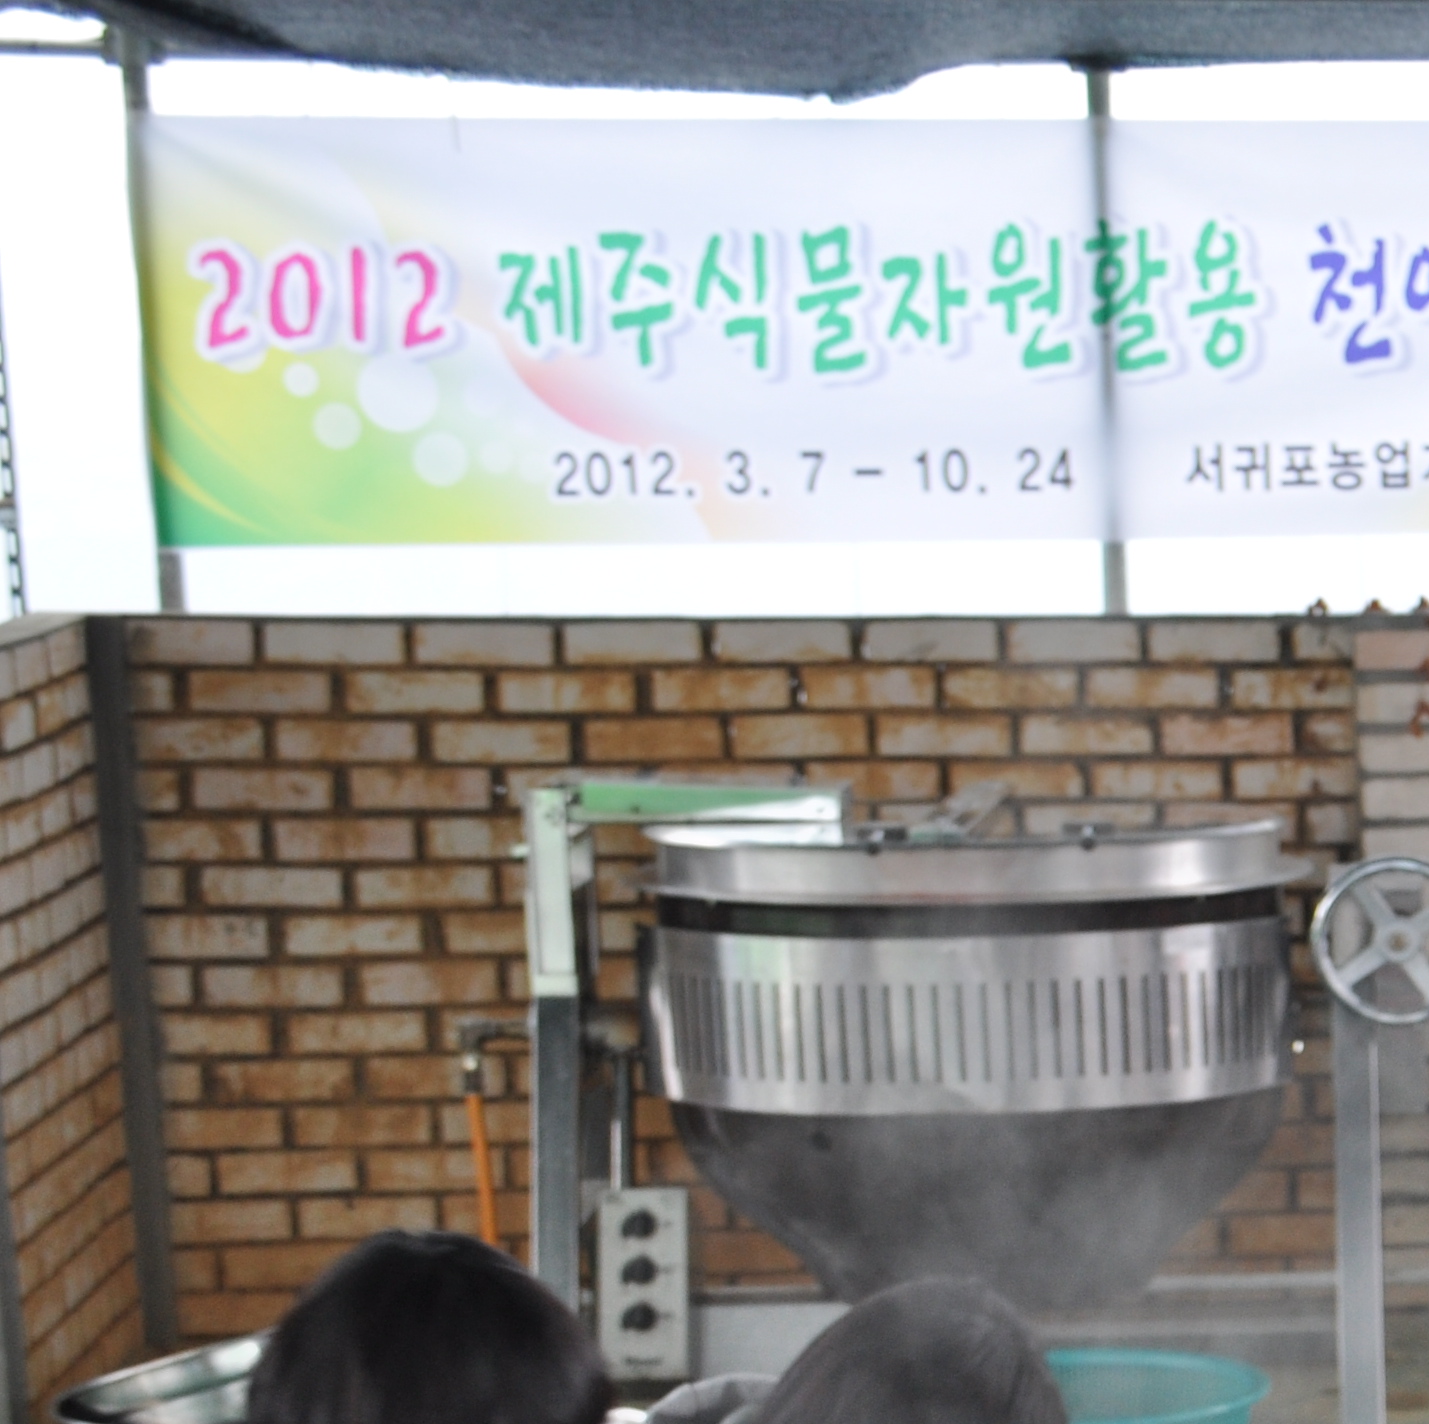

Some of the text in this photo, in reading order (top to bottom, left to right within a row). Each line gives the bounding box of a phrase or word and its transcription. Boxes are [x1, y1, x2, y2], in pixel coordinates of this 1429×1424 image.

[200, 246, 446, 349] 2012
[498, 219, 1256, 374] 제주식물자원활용
[555, 450, 698, 497] 2012.
[726, 450, 773, 497] 3.
[799, 450, 824, 493] 7
[914, 447, 989, 494] 10.
[1017, 446, 1074, 493] 24
